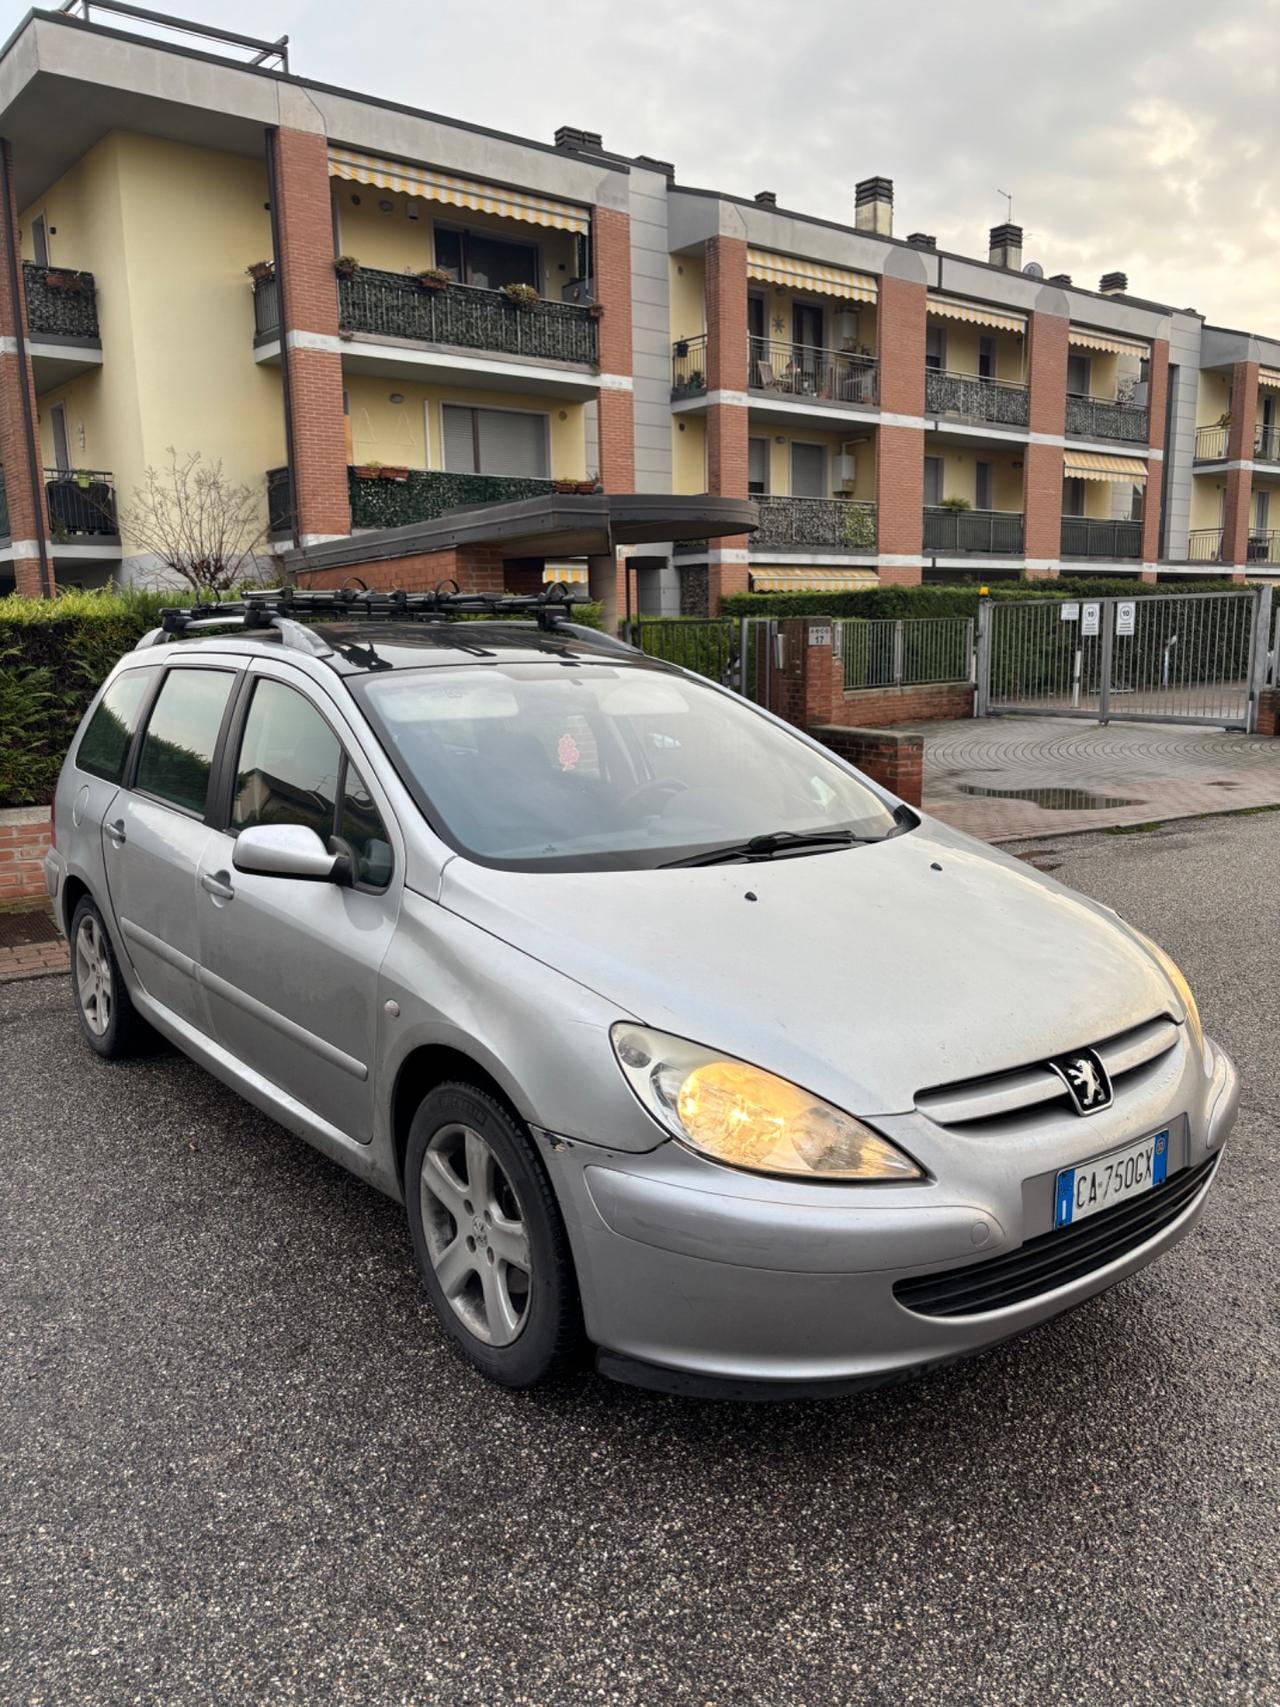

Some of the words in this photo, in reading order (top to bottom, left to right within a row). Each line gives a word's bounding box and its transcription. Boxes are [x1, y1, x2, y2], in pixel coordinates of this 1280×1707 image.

[815, 635, 824, 644] 17
[1076, 1172, 1098, 1208] CA
[1103, 1147, 1153, 1197] 750GX
[1062, 1200, 1067, 1220] I
